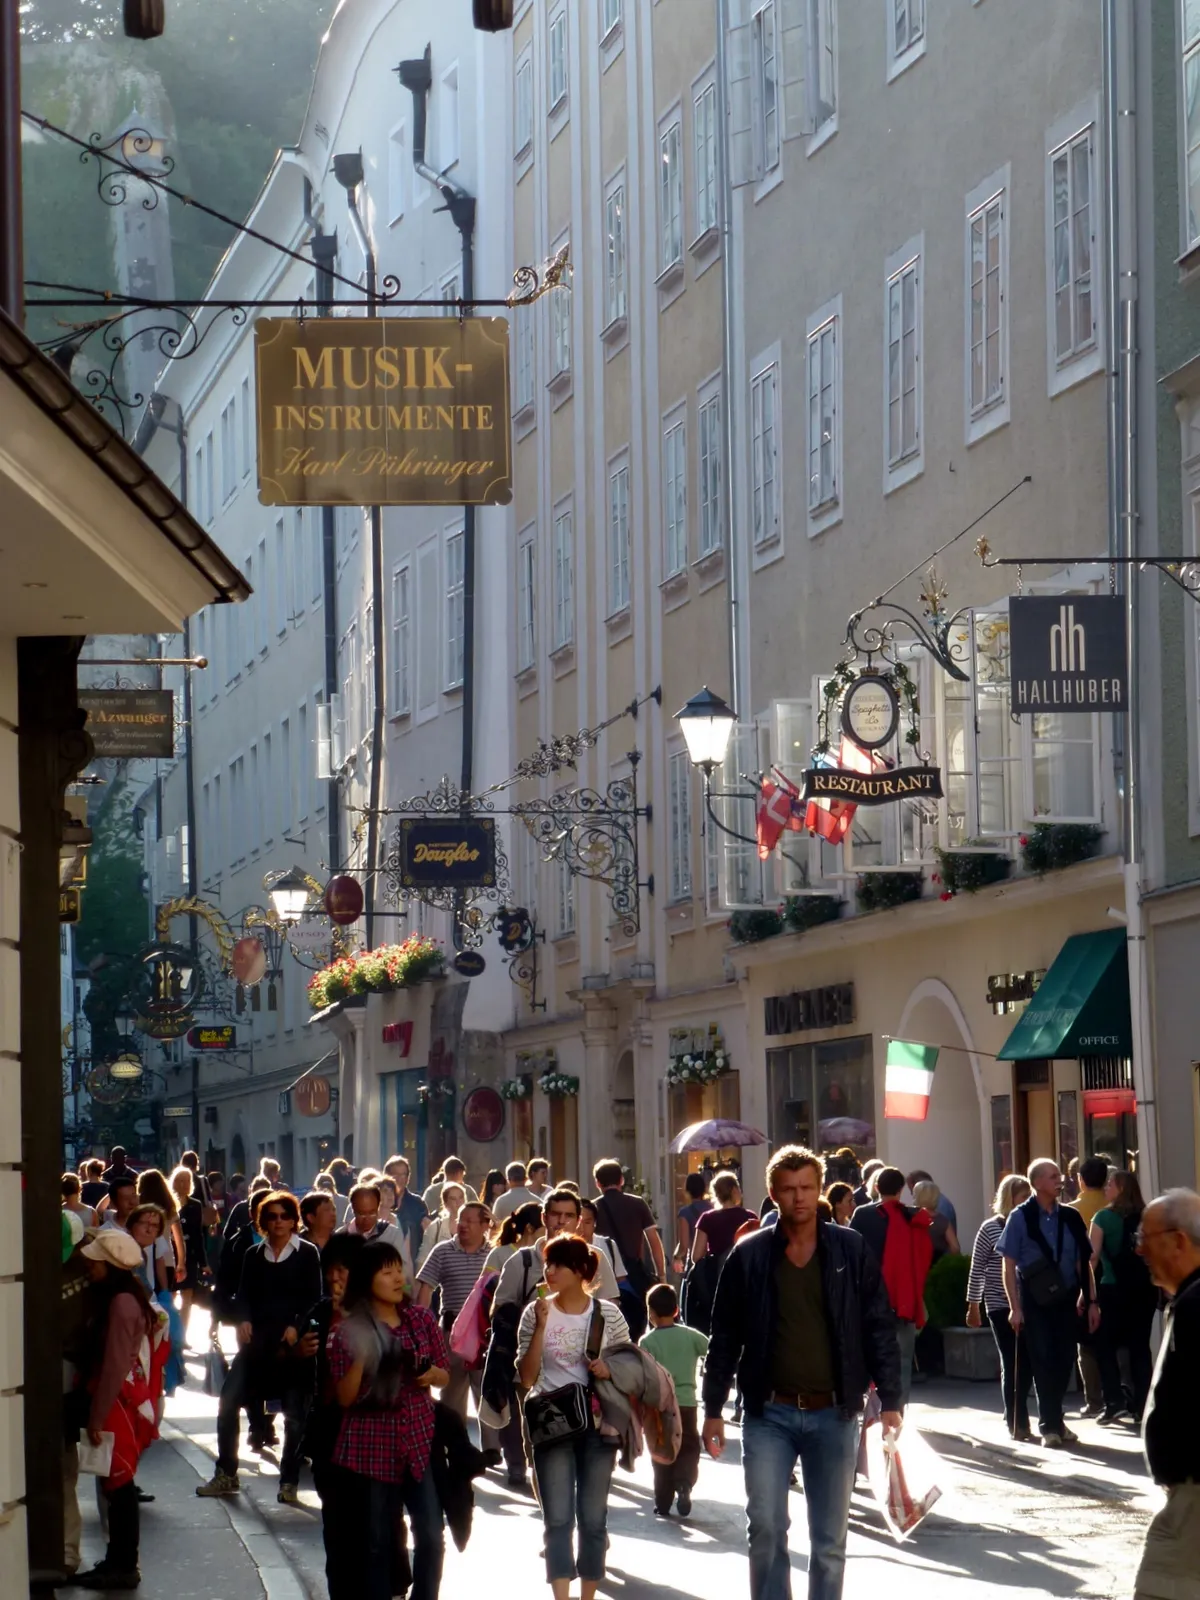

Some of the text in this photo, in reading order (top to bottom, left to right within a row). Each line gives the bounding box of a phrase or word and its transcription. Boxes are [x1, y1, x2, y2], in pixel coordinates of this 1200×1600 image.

[292, 347, 473, 389] MUSIK-
[273, 405, 494, 430] INSTRUMENTE
[275, 446, 495, 485] Karl Pühringer
[1018, 679, 1121, 704] HALLHUBER
[96, 710, 167, 725] Azwanger
[813, 774, 935, 796] RESTAURANT
[413, 841, 480, 868] Douglas
[1079, 1035, 1120, 1046] OFFICE
